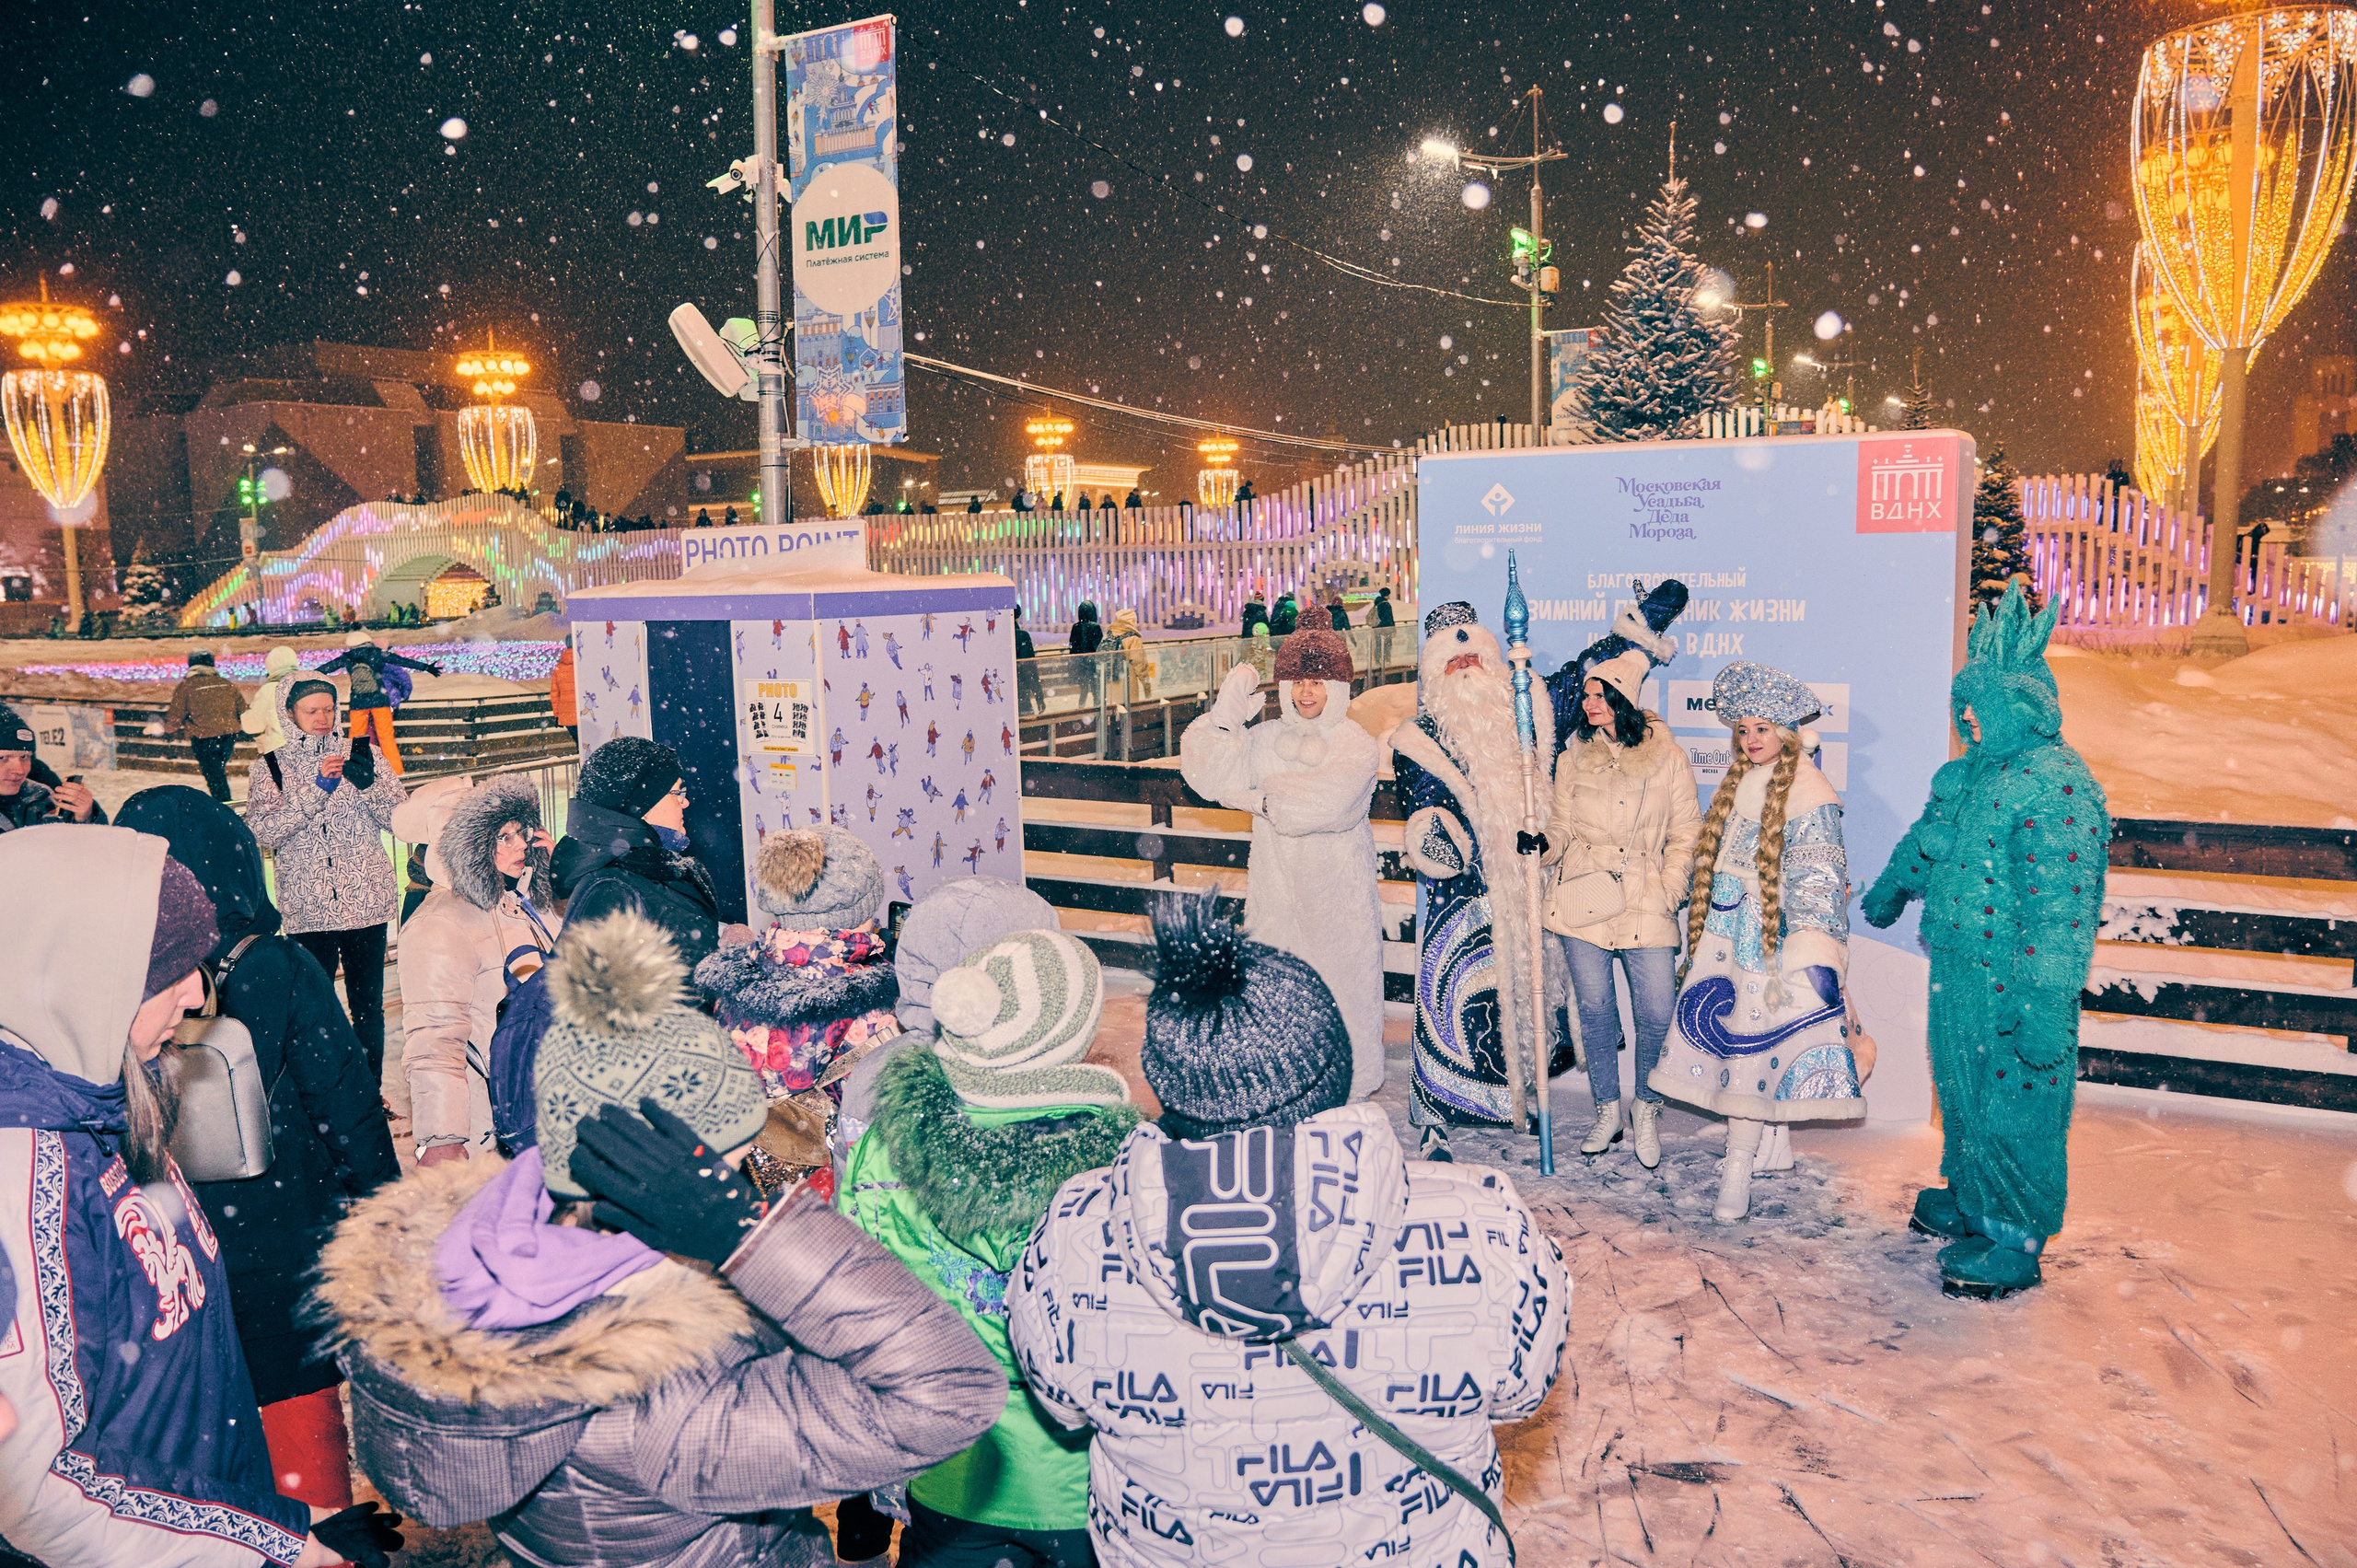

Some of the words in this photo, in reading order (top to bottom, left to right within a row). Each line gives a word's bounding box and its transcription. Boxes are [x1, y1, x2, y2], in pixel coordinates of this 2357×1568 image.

[806, 211, 888, 251] МИР
[806, 257, 853, 268] Платёжная
[854, 250, 889, 261] система
[1615, 477, 1722, 496] Московская
[1633, 493, 1705, 512] Усадьба
[1871, 501, 1943, 520] ВДНХ
[1643, 509, 1689, 526] Деда
[1455, 524, 1494, 534] ЛИНИЯ
[1498, 523, 1542, 533] ЖИЗНИ
[1629, 523, 1697, 542] Мороза
[686, 535, 768, 567] PHOTO
[778, 530, 859, 552] POI
[1455, 536, 1522, 544] благотворительный
[1528, 591, 1607, 621] ЗИМНИЙ
[1728, 599, 1805, 622] ЖИЗНИ
[1686, 633, 1745, 658] ВДНХ
[758, 683, 797, 698] PHOTO
[773, 703, 783, 723] 4
[1689, 748, 1713, 764] Time
[1713, 749, 1731, 765] Out
[1399, 1254, 1482, 1288] FILA
[1092, 1370, 1178, 1403] FILA
[1386, 1372, 1482, 1402] FILA
[1237, 1441, 1336, 1476] FILA
